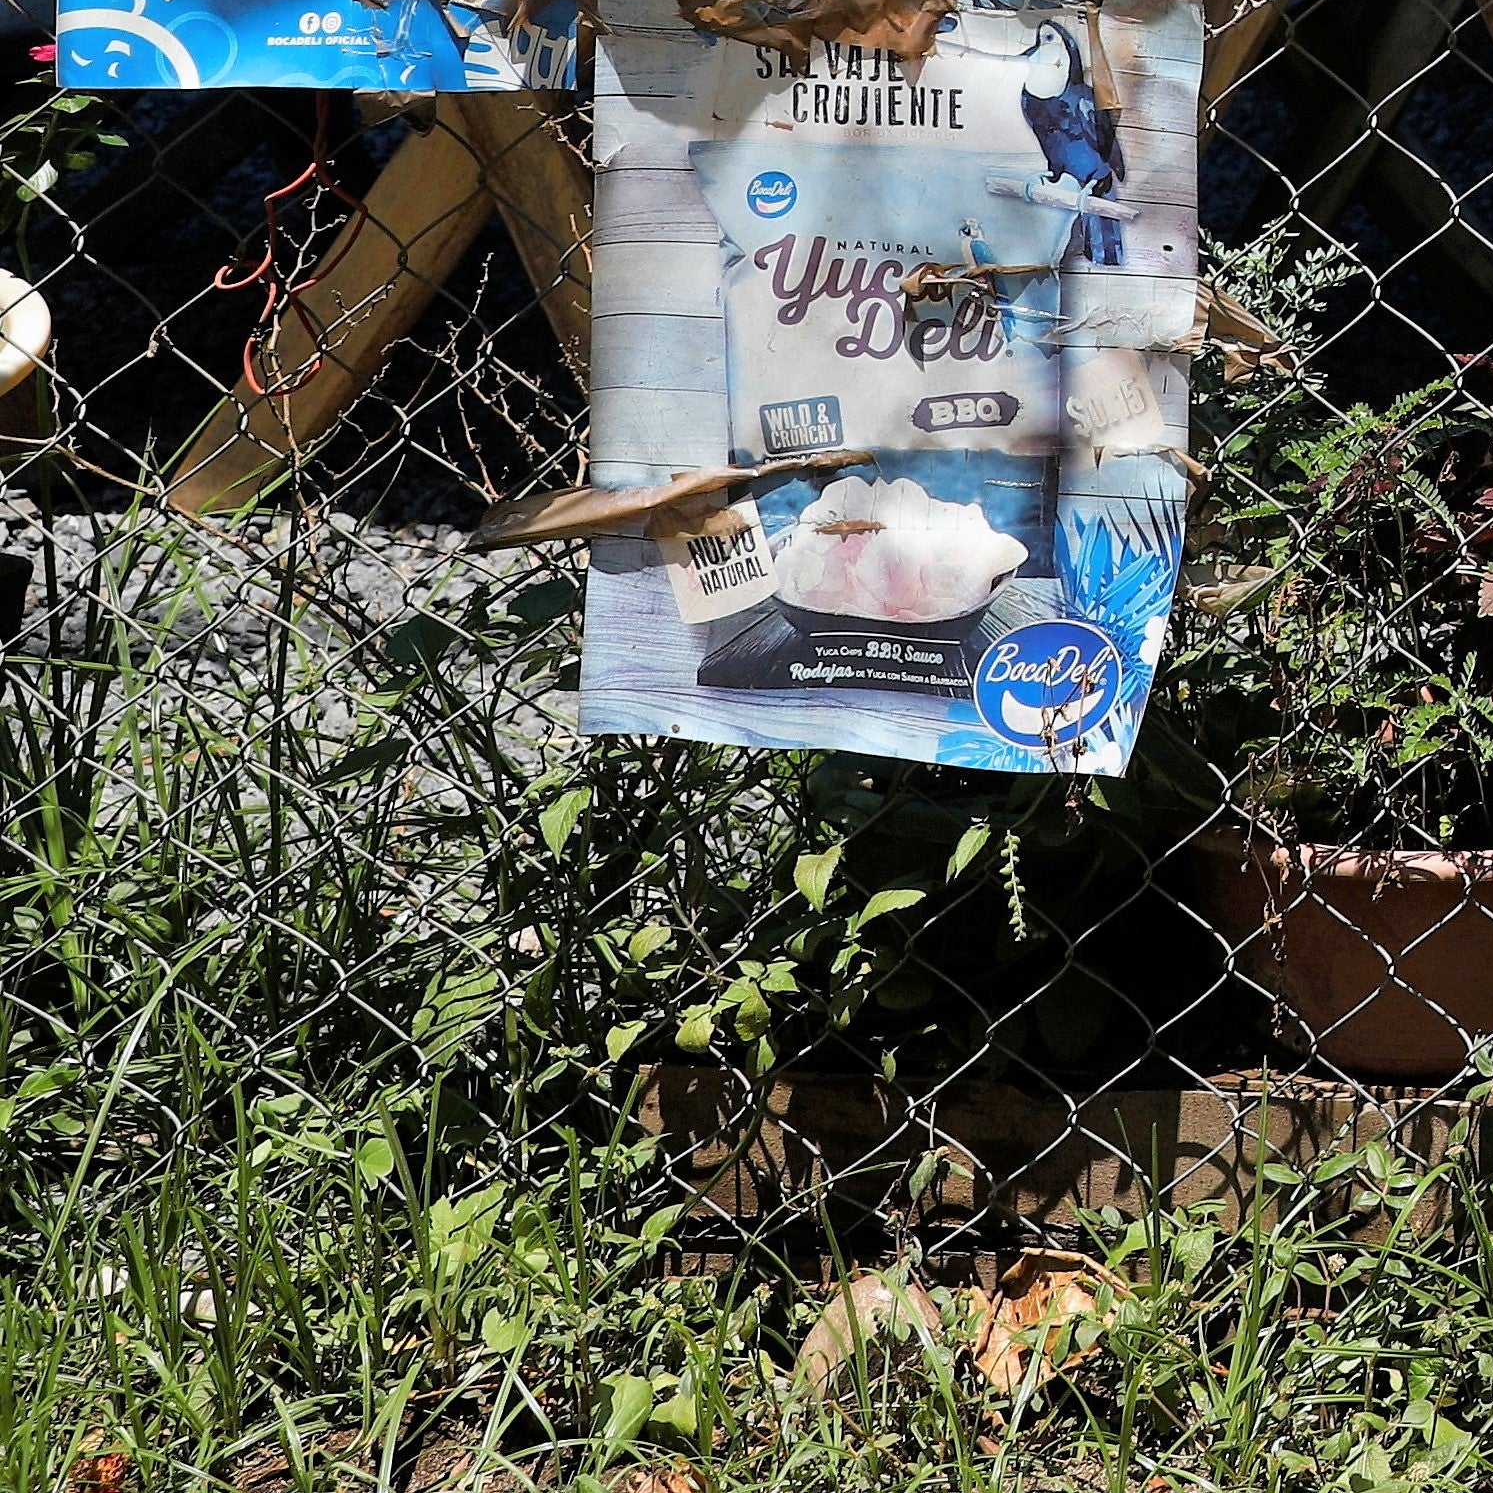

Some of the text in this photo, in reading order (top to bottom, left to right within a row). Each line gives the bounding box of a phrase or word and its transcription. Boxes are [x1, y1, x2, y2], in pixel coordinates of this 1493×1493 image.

[267, 36, 323, 47] BOCADELI
[792, 82, 965, 130] CRUJIENTE
[837, 240, 935, 255] NATURAL
[835, 292, 1004, 362] Deli
[763, 402, 830, 432] WILD &
[929, 397, 1001, 426] BBQ
[770, 422, 837, 450] CRUNCHY
[699, 555, 769, 597] NATURAL
[985, 642, 1113, 687] BocaDeli
